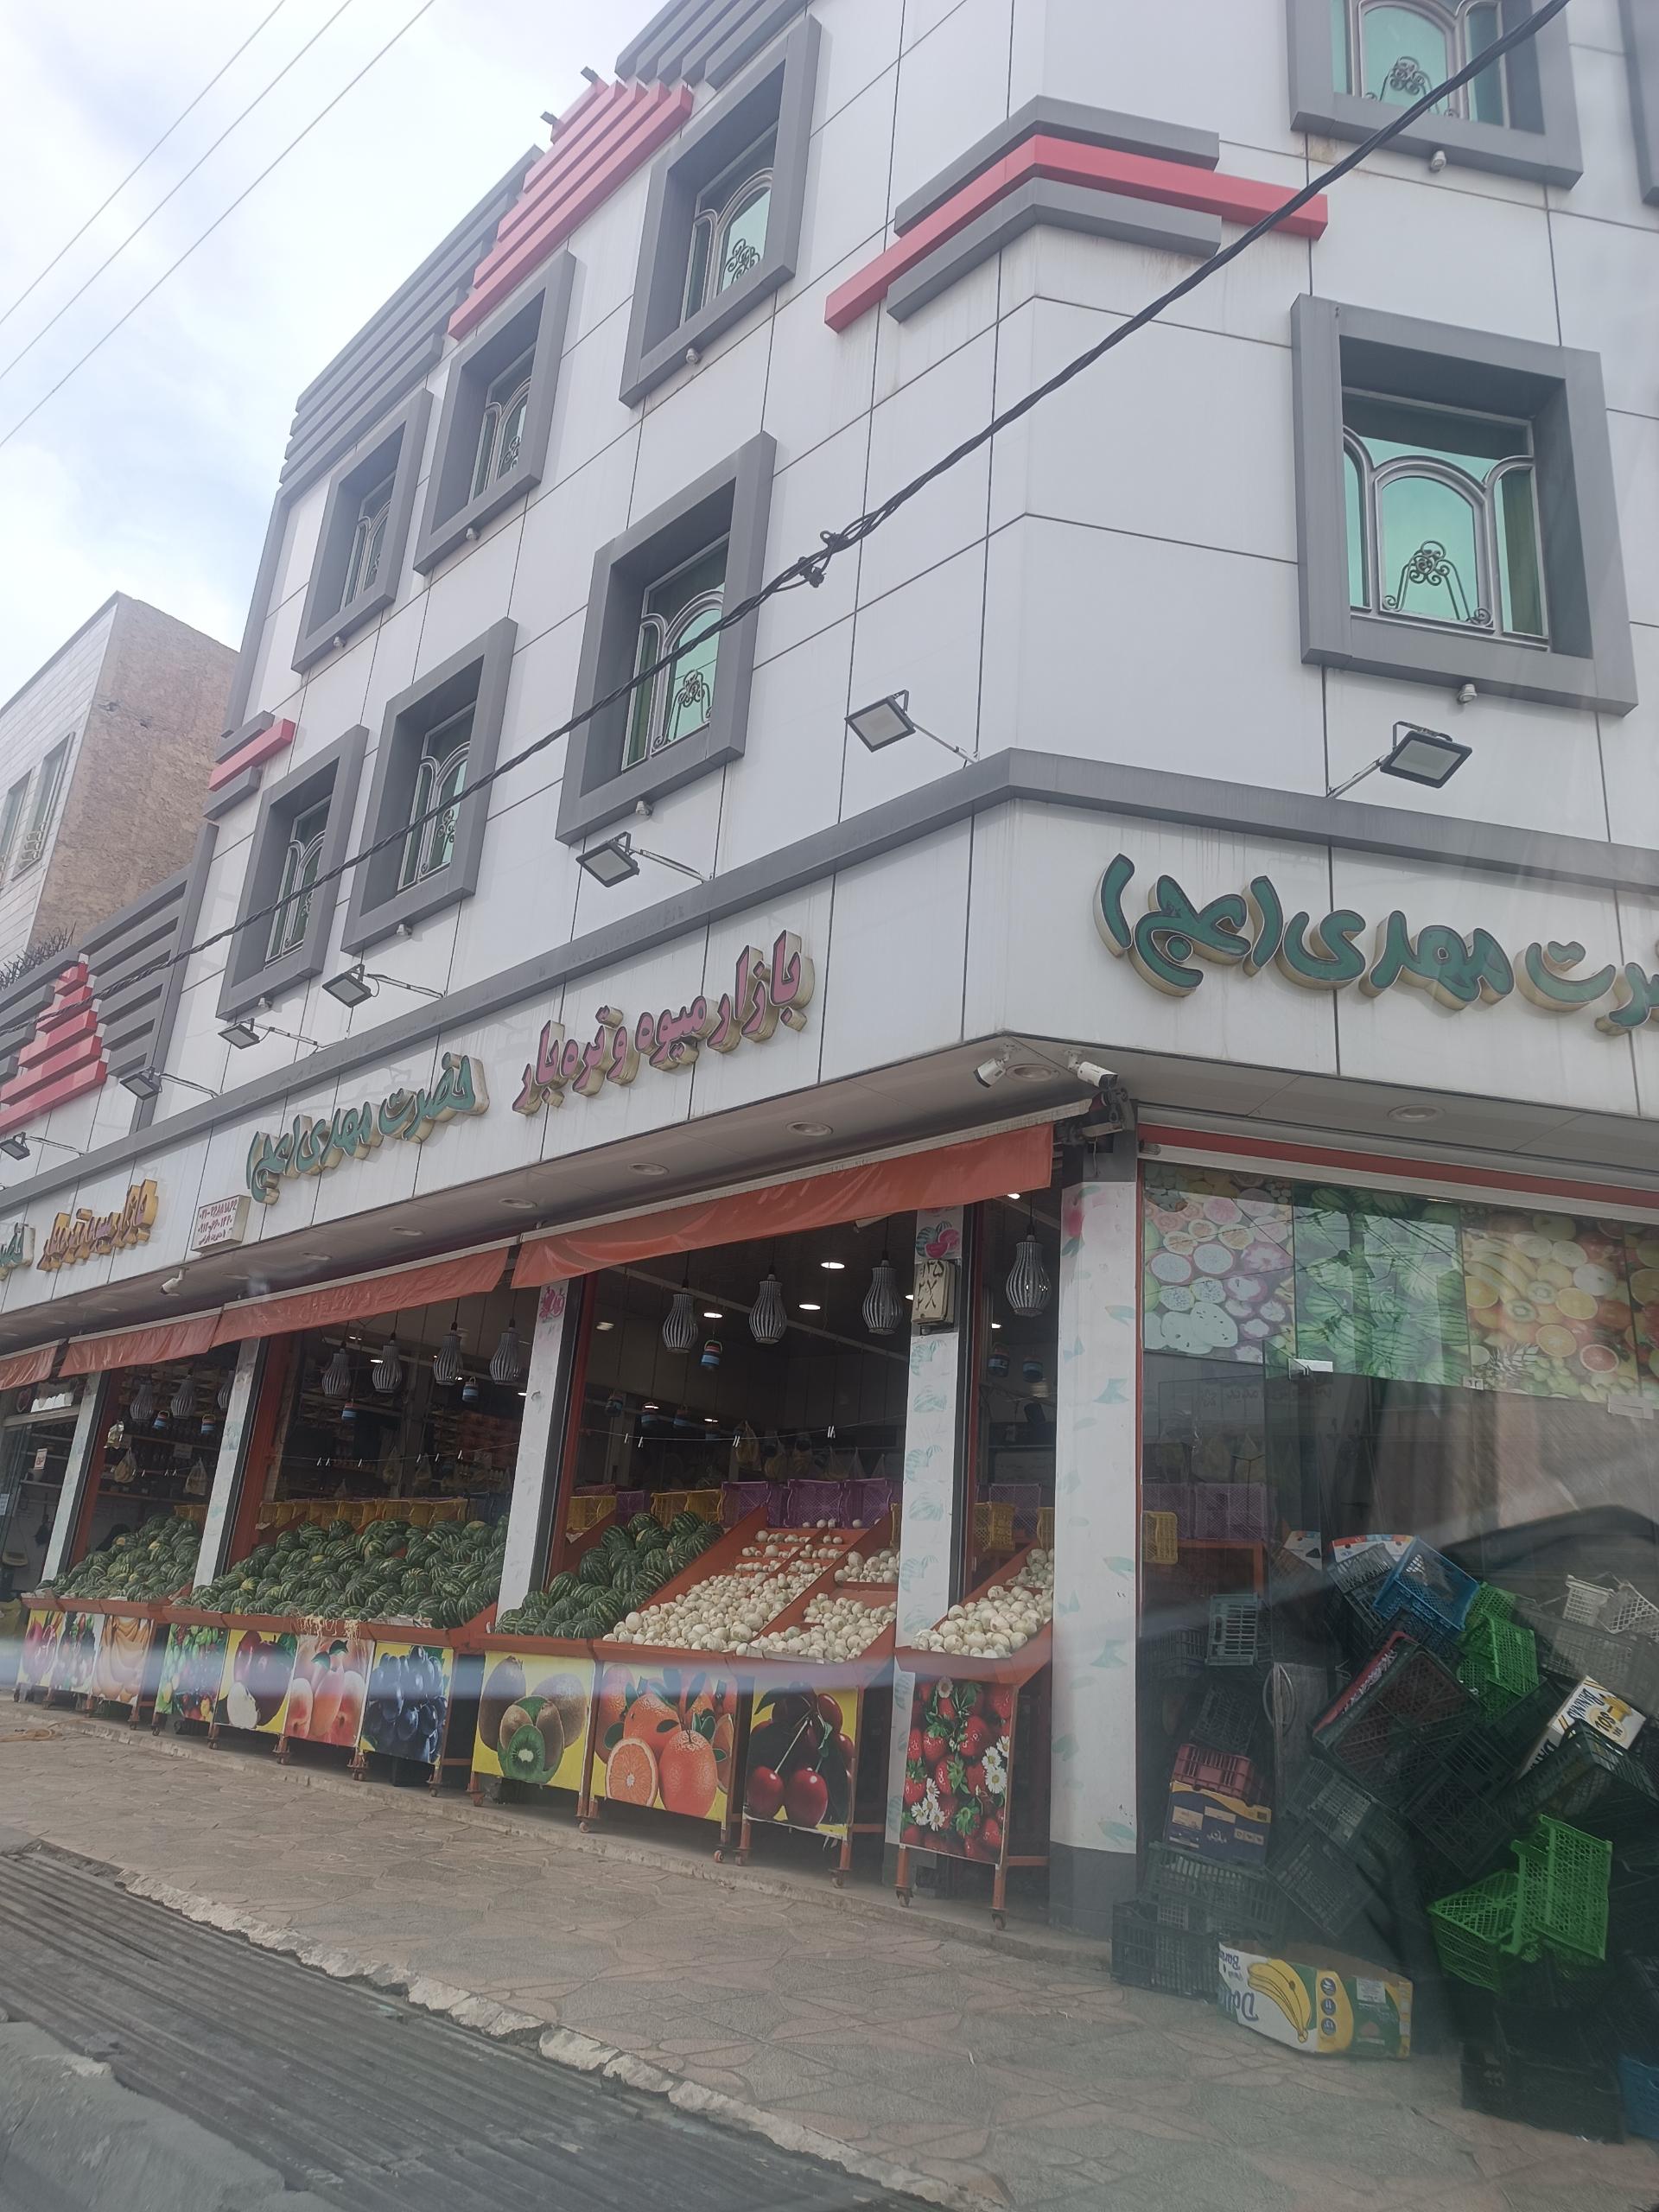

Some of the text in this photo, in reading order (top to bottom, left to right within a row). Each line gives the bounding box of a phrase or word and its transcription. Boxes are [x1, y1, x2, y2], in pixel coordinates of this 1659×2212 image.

[708, 930, 815, 1053] بازار
[1275, 909, 1515, 1011] مهدی
[512, 1020, 565, 1116] بار
[635, 995, 715, 1071] میوه
[296, 1101, 385, 1176] مهدی
[111, 1179, 158, 1249] بازار
